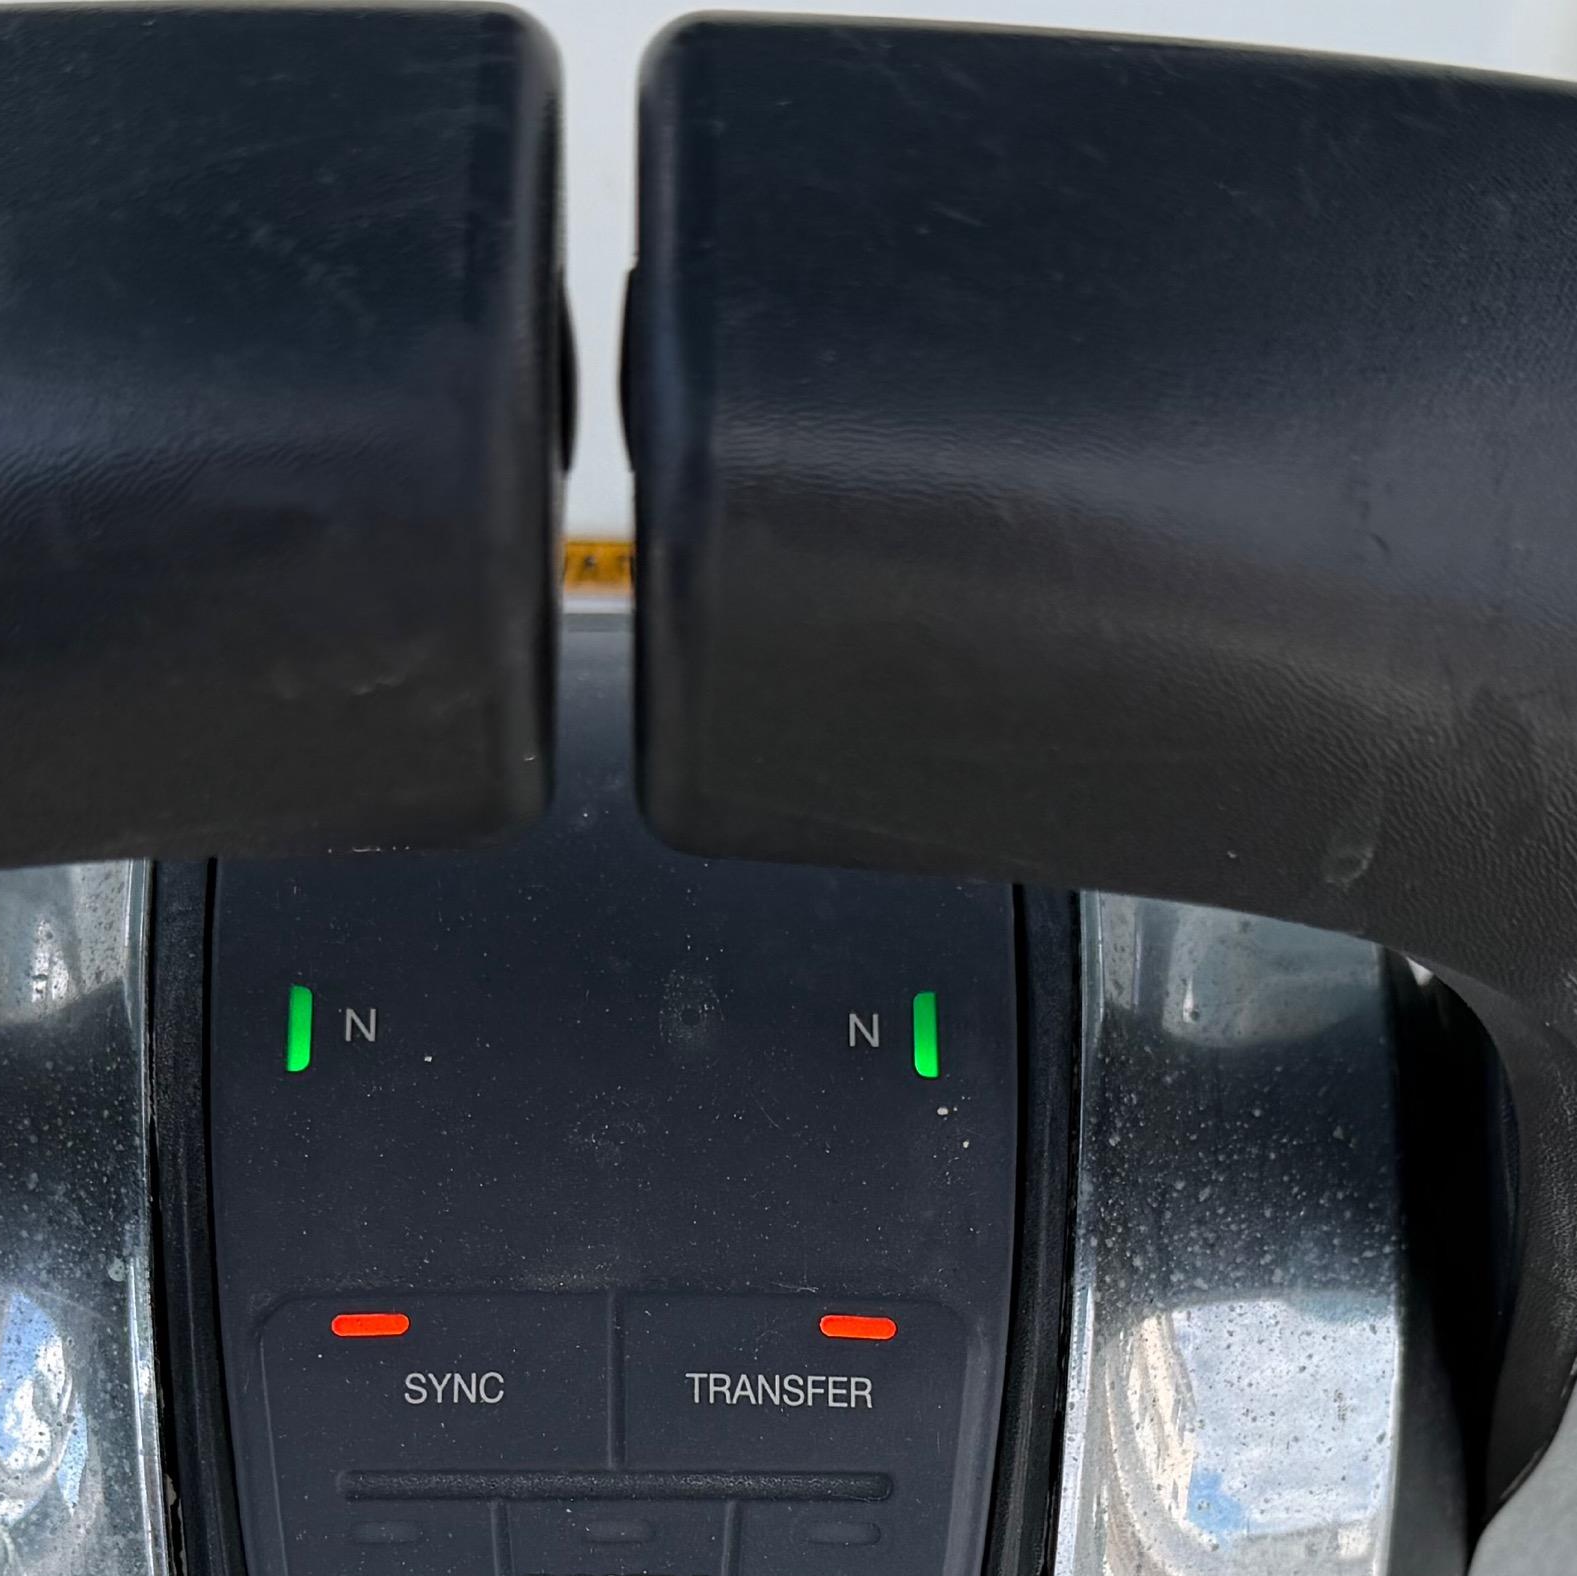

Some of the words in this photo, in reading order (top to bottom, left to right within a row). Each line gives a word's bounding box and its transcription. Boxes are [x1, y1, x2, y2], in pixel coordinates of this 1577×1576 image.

[344, 1007, 378, 1042] N
[848, 1012, 880, 1048] N
[403, 1370, 506, 1405] SYNC
[685, 1371, 874, 1409] TRANSFER
